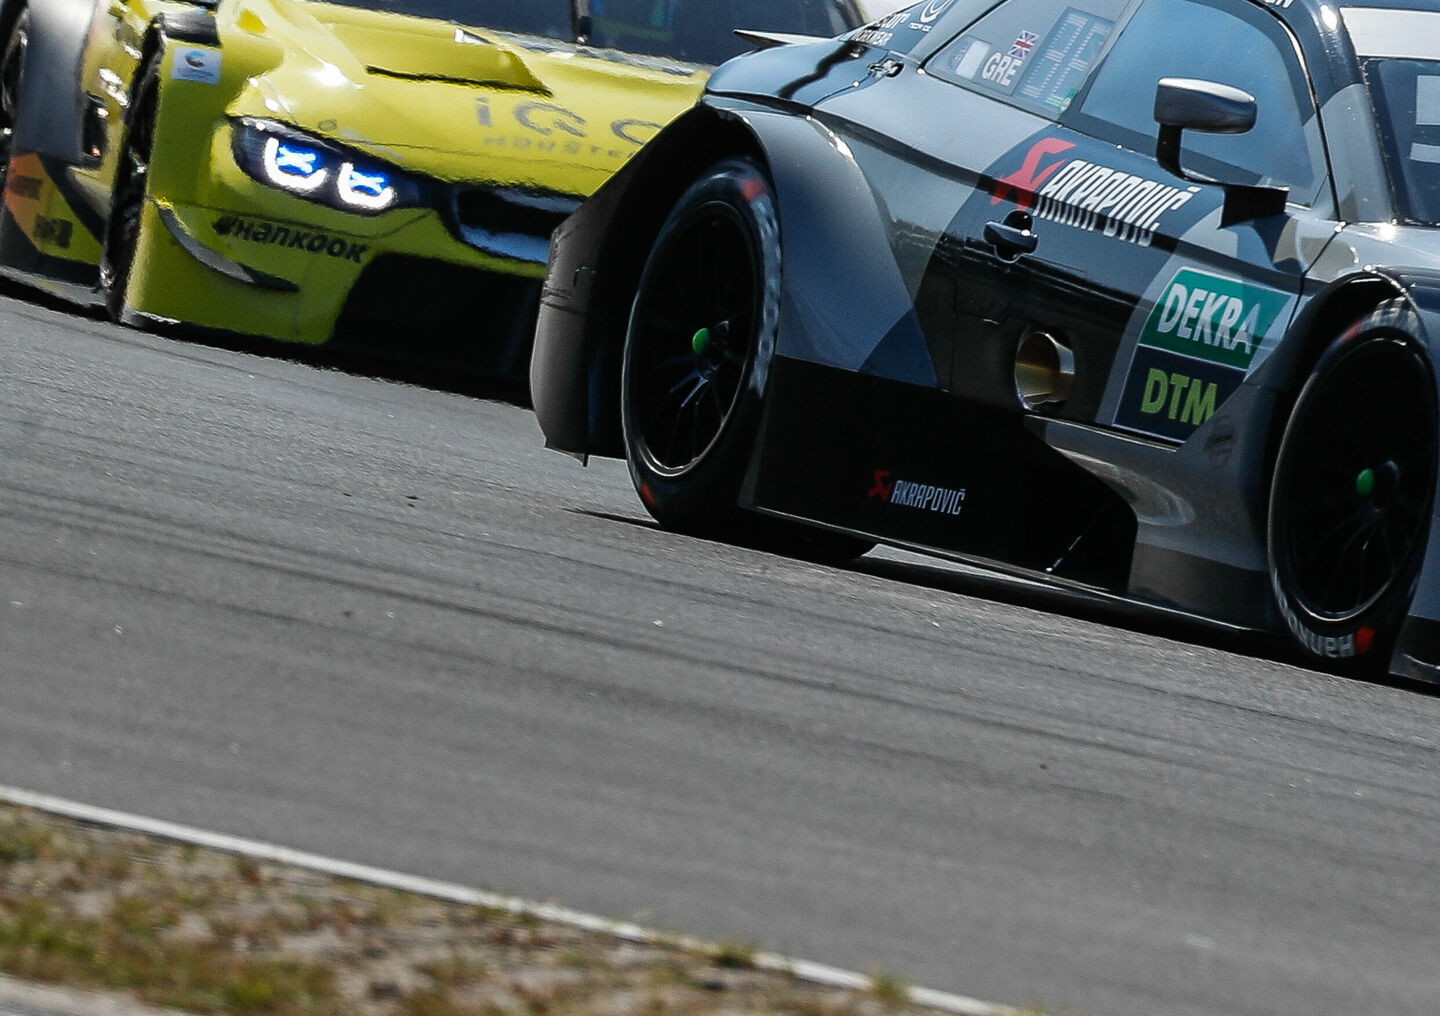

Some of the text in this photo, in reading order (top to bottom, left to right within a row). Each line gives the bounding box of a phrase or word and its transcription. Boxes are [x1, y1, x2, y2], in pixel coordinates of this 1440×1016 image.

[981, 52, 1024, 87] GRE
[1156, 282, 1262, 355] DEKRA
[1140, 368, 1220, 426] DTM
